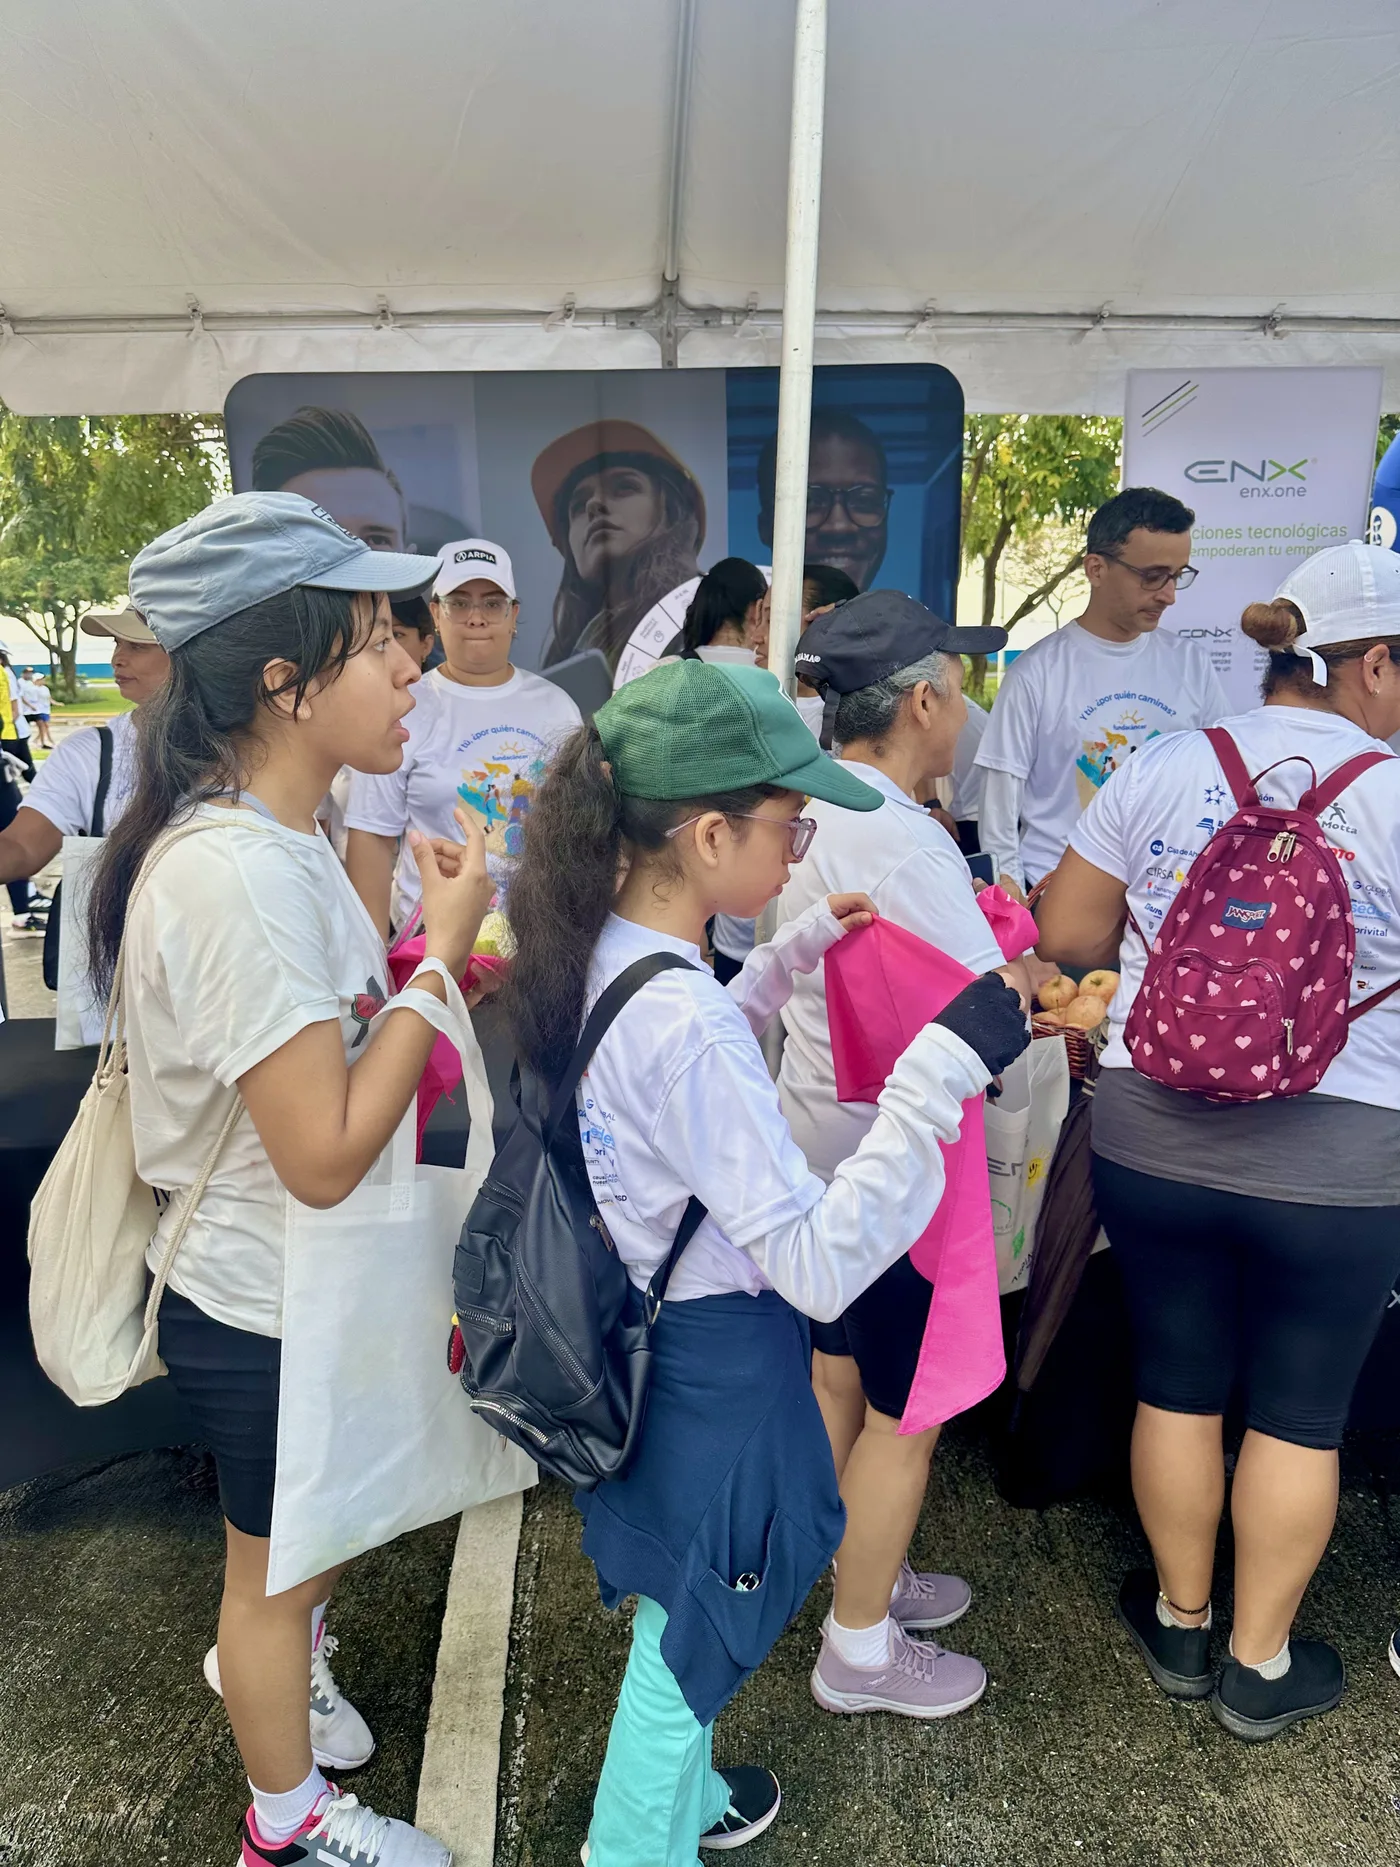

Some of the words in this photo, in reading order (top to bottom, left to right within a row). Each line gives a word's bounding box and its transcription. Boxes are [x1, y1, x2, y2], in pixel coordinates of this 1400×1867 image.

[1184, 459, 1308, 483] ENX
[1239, 486, 1307, 499] enx.one
[1248, 522, 1348, 543] tecnológicas
[467, 551, 495, 562] ARPIA
[1190, 546, 1265, 561] empoderan
[1268, 545, 1283, 557] tu
[1096, 694, 1112, 707] ¿por
[1114, 691, 1136, 700] quién
[1138, 693, 1177, 717] caminas?
[471, 729, 489, 741] ¿por
[491, 724, 515, 734] quién
[1321, 821, 1358, 835] Motta
[1146, 867, 1174, 880] CIRSA
